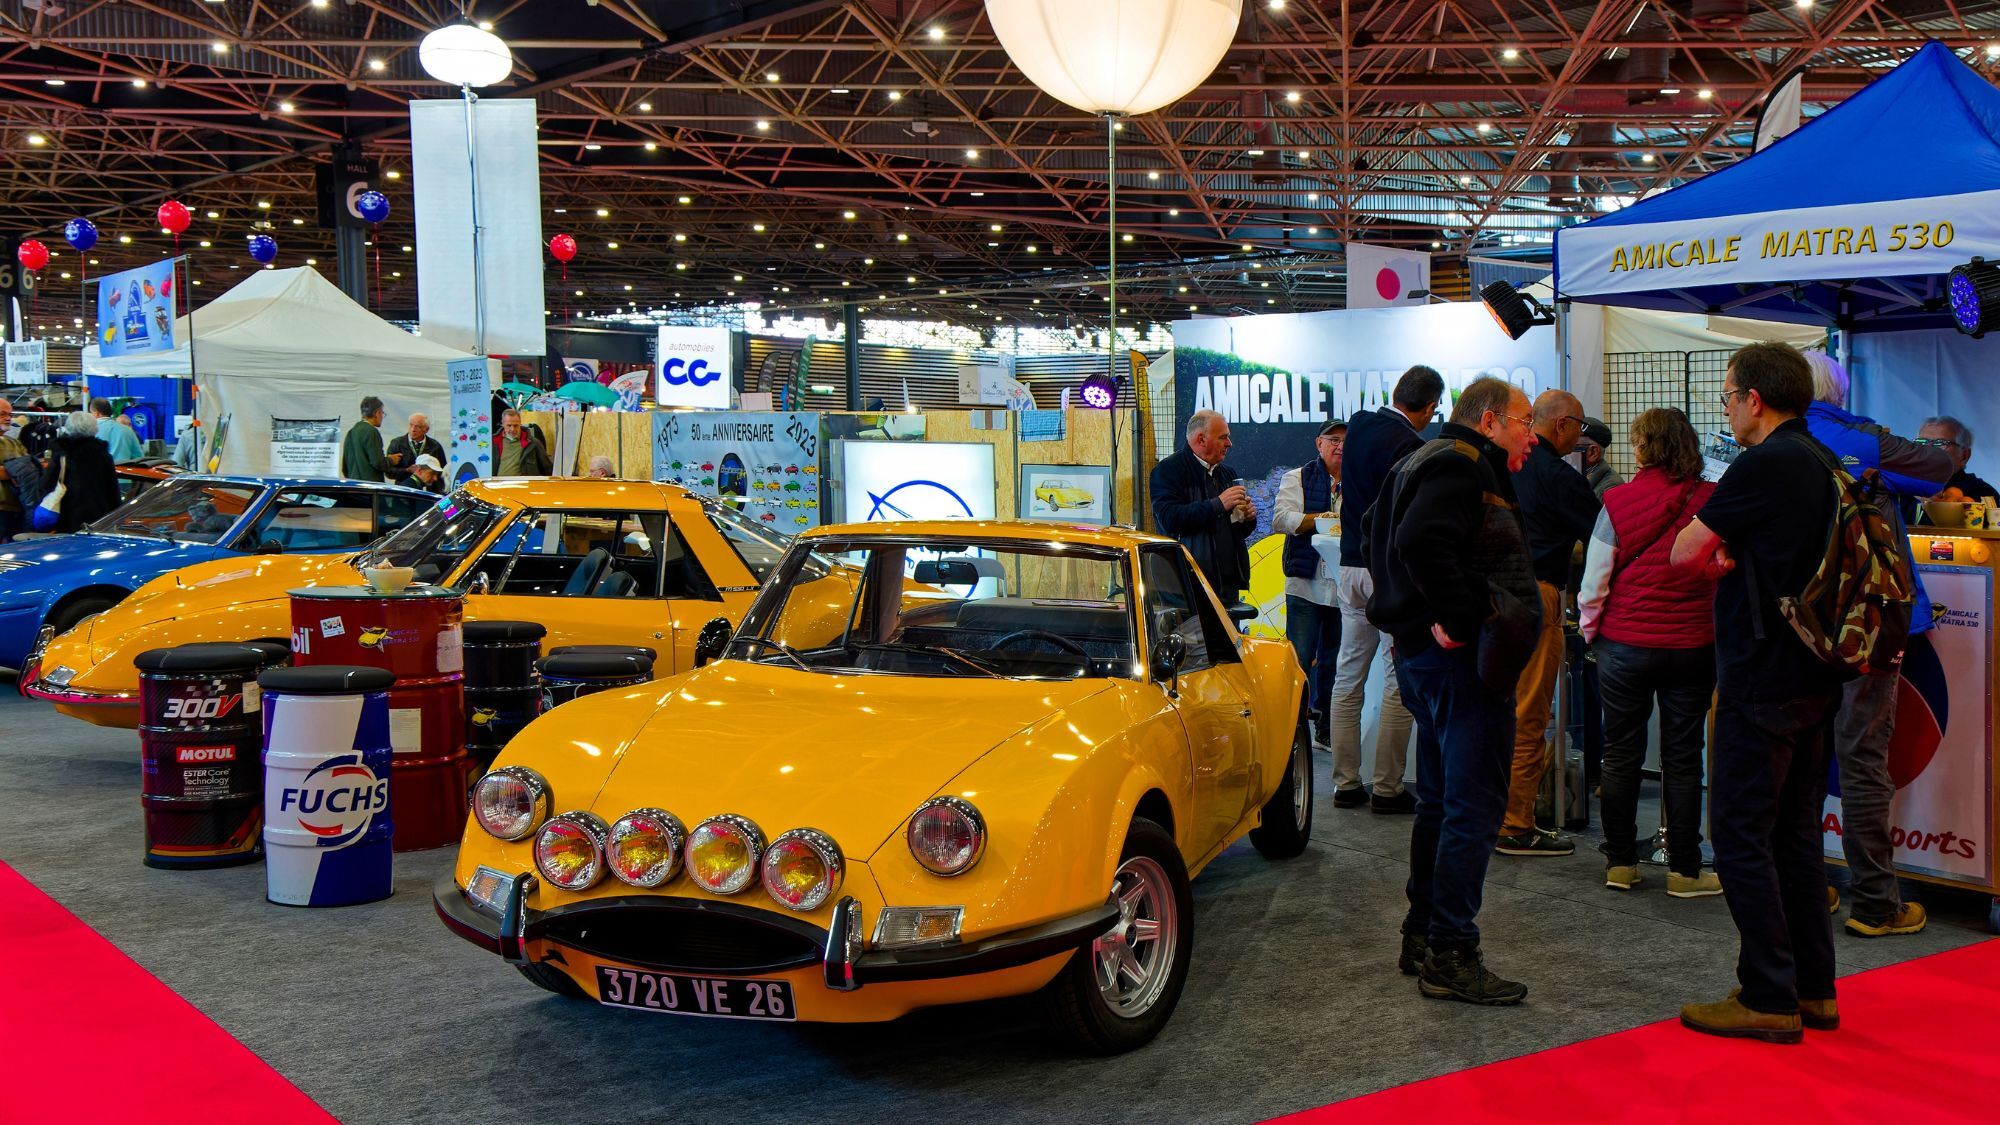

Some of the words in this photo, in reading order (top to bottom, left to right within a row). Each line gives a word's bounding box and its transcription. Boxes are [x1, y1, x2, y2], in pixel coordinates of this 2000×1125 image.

[347, 163, 368, 173] HALL
[346, 181, 369, 219] 6
[1609, 235, 1742, 273] AMICALE
[1760, 224, 1878, 259] MATRA
[1886, 220, 1955, 252] 530
[668, 342, 715, 353] automobiles
[1194, 372, 1328, 425] AMICALE
[657, 415, 679, 452] 1973
[691, 423, 701, 441] 50
[712, 423, 774, 442] ANNIVERSAIRE
[786, 415, 817, 458] 2023
[1940, 618, 1966, 627] MATRA
[1966, 620, 1979, 628] 530
[1946, 609, 1979, 618] AMICALE
[290, 626, 310, 655] bil
[163, 693, 242, 718] 300V
[179, 747, 234, 761] MOTUL
[183, 769, 207, 777] ESTER
[183, 776, 230, 786] Technology
[280, 782, 386, 814] FUCHS
[1890, 825, 1976, 860] ports
[604, 968, 679, 1009] 3720
[691, 978, 732, 1013] VE
[745, 982, 785, 1016] 26
